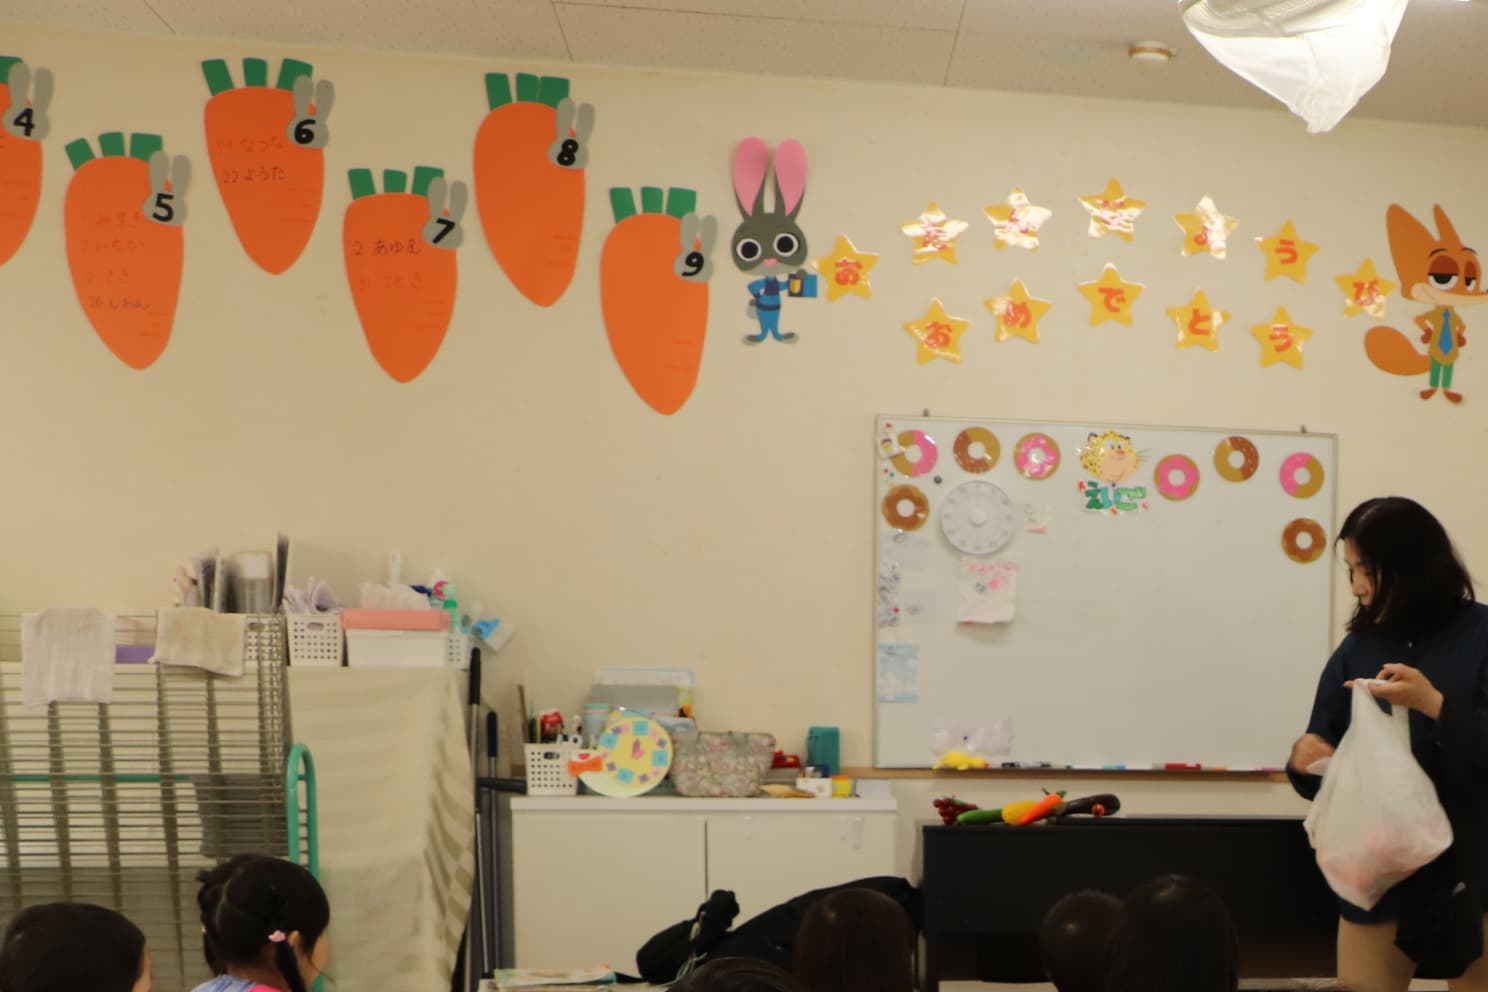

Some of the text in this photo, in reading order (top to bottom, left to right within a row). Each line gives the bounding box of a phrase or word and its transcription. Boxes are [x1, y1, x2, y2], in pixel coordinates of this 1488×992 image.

[13, 107, 35, 137] 4
[293, 119, 317, 143] 6
[556, 138, 579, 167] 8
[151, 192, 175, 223] 5
[431, 217, 457, 245] 7
[681, 251, 704, 278] 9
